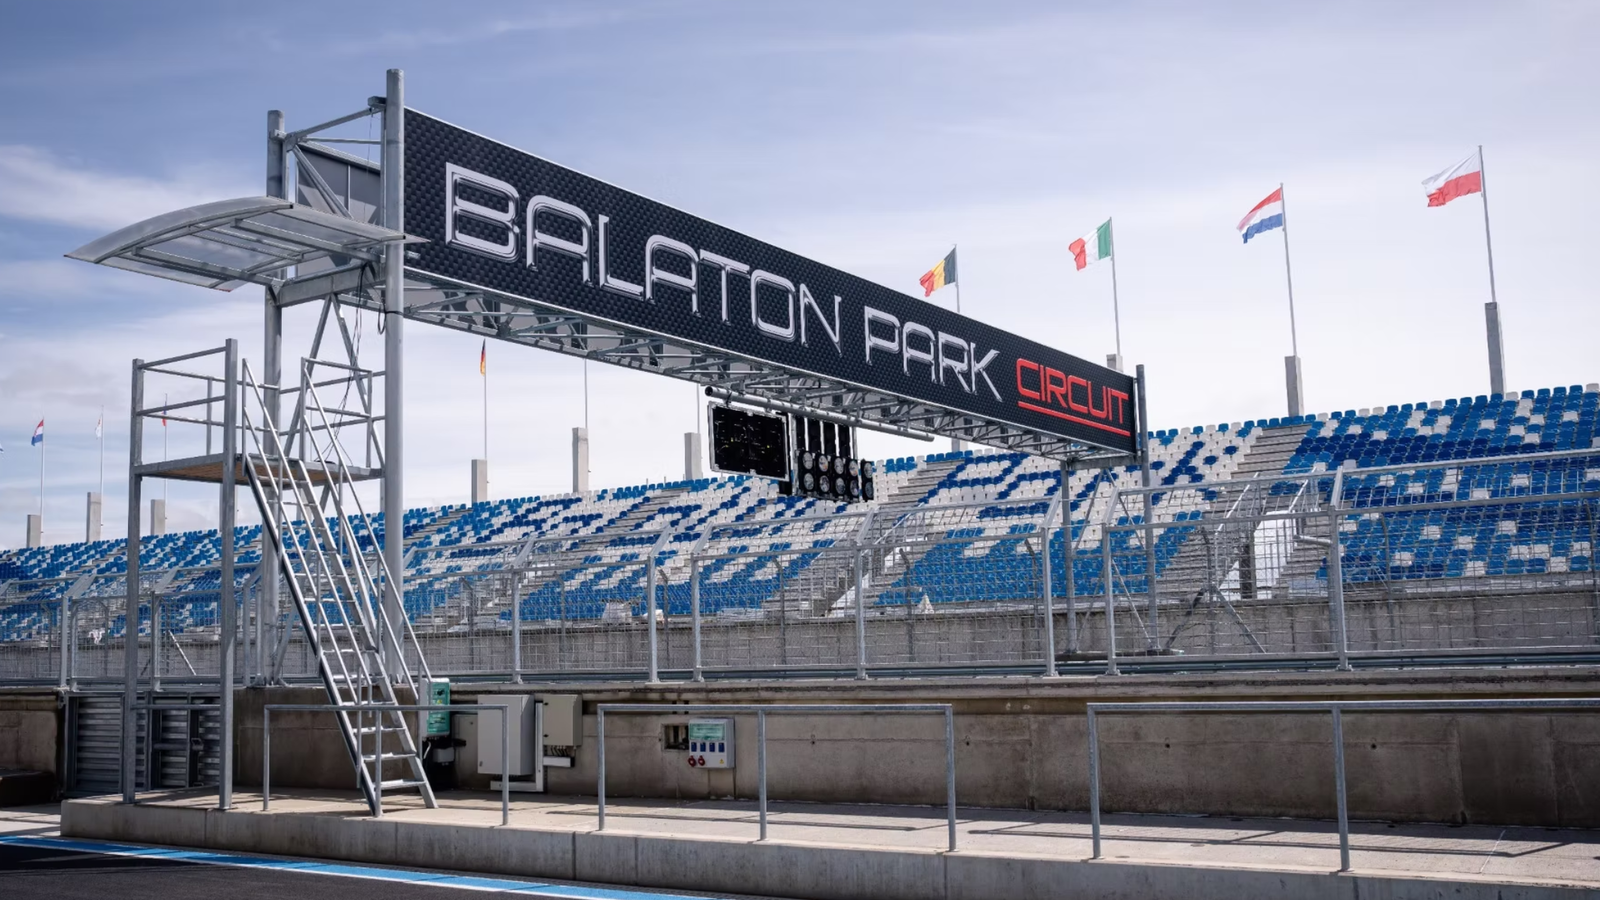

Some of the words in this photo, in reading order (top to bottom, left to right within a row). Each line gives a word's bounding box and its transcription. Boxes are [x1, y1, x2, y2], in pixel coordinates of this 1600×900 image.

[445, 162, 842, 358] BALATON
[864, 305, 1003, 402] PARK
[1016, 357, 1129, 424] CIRCUIT
